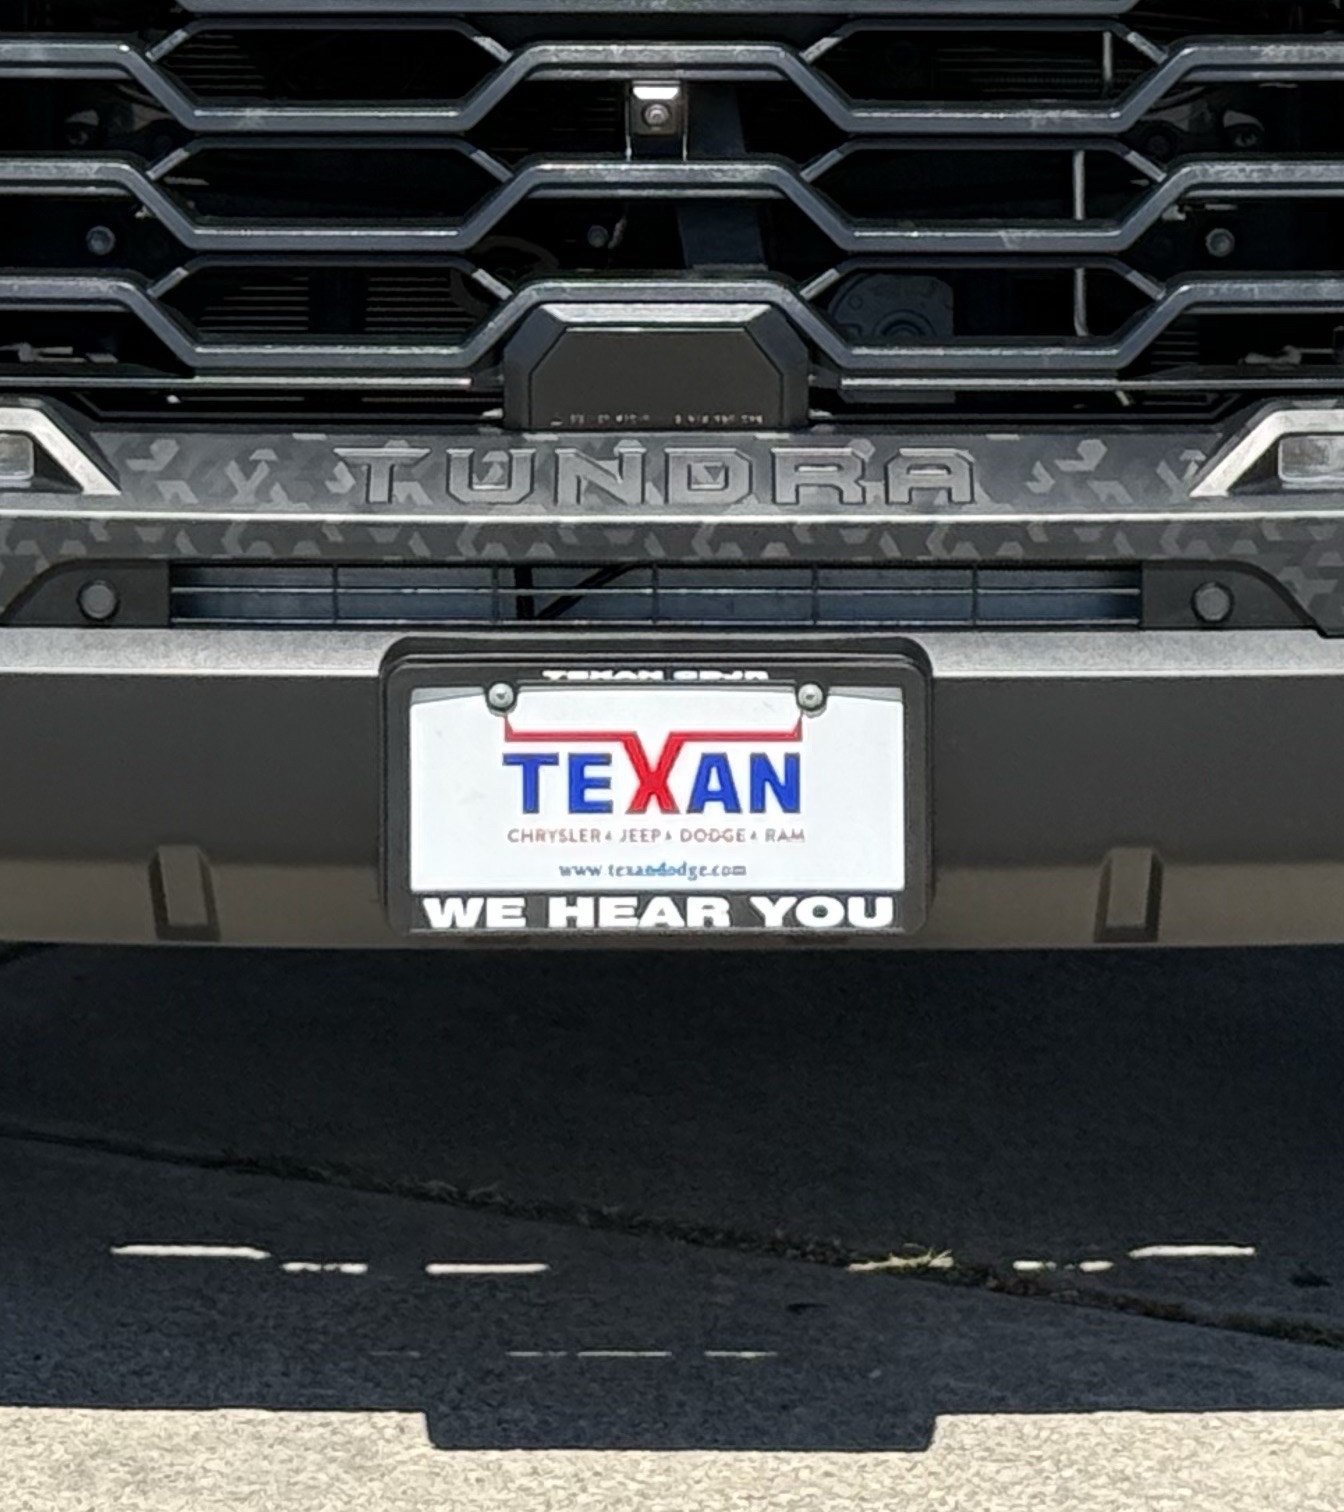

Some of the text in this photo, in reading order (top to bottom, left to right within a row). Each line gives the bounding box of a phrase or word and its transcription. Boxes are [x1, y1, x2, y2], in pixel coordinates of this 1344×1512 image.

[331, 445, 980, 507] TUNDRA
[502, 728, 803, 816] TEXAN
[506, 827, 806, 844] CHRYSLER JEEP DODGE RAM
[558, 861, 747, 882] www.texandodge.com
[423, 896, 895, 930] WE HEAR YOU
